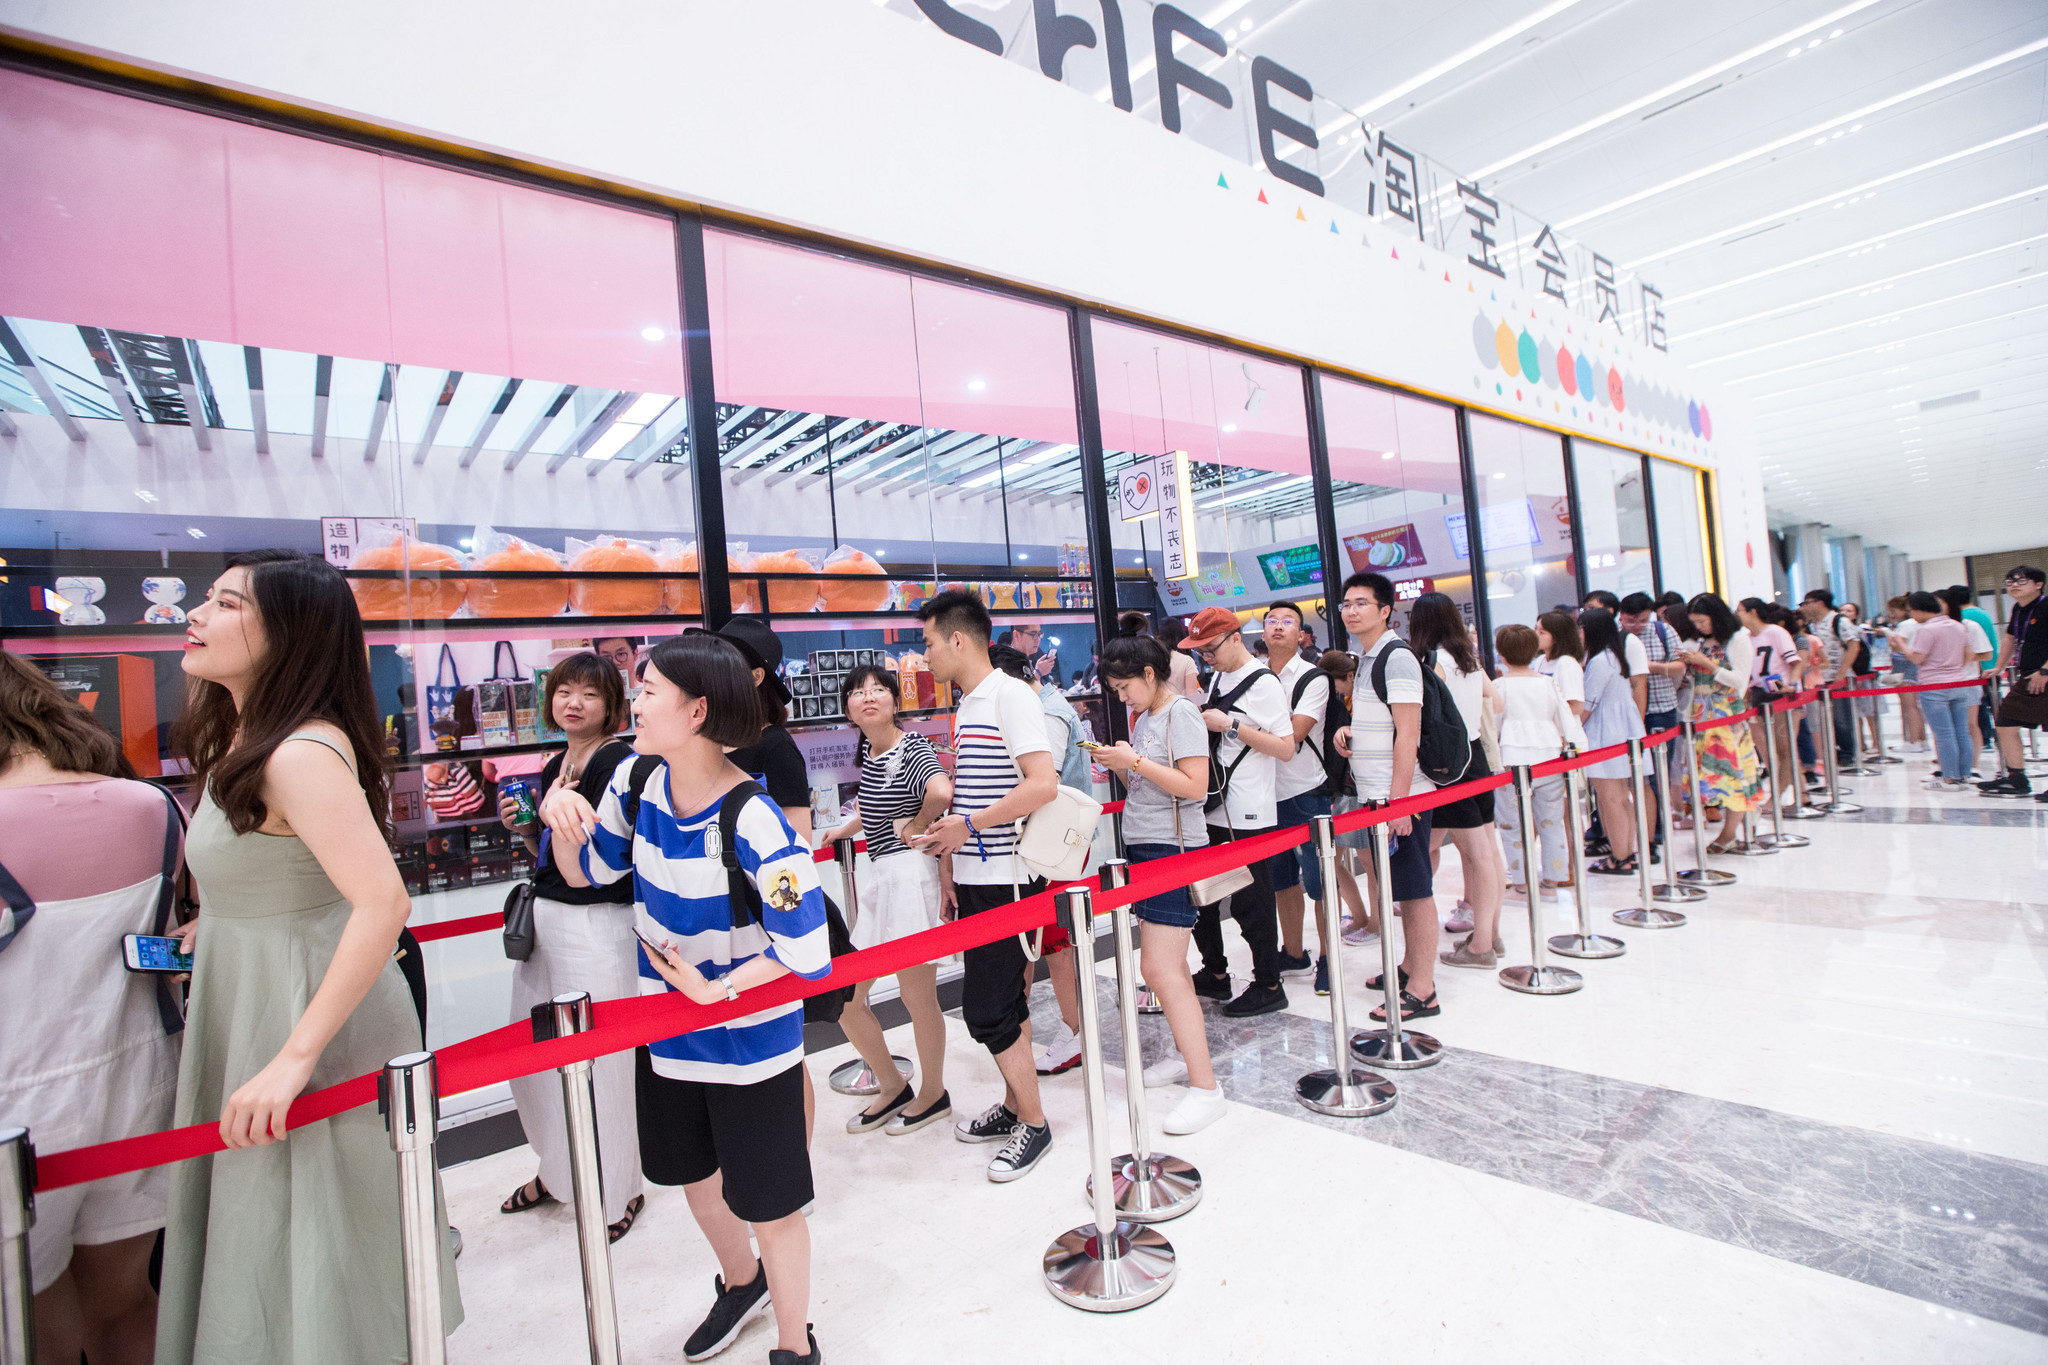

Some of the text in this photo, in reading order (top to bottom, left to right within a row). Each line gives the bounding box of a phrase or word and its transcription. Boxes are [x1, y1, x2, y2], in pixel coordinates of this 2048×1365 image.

[1361, 120, 1668, 353] 淘宝会员店
[329, 522, 350, 570] 造物
[1161, 460, 1182, 570] 玩物不丧志
[1756, 646, 1773, 677] 7
